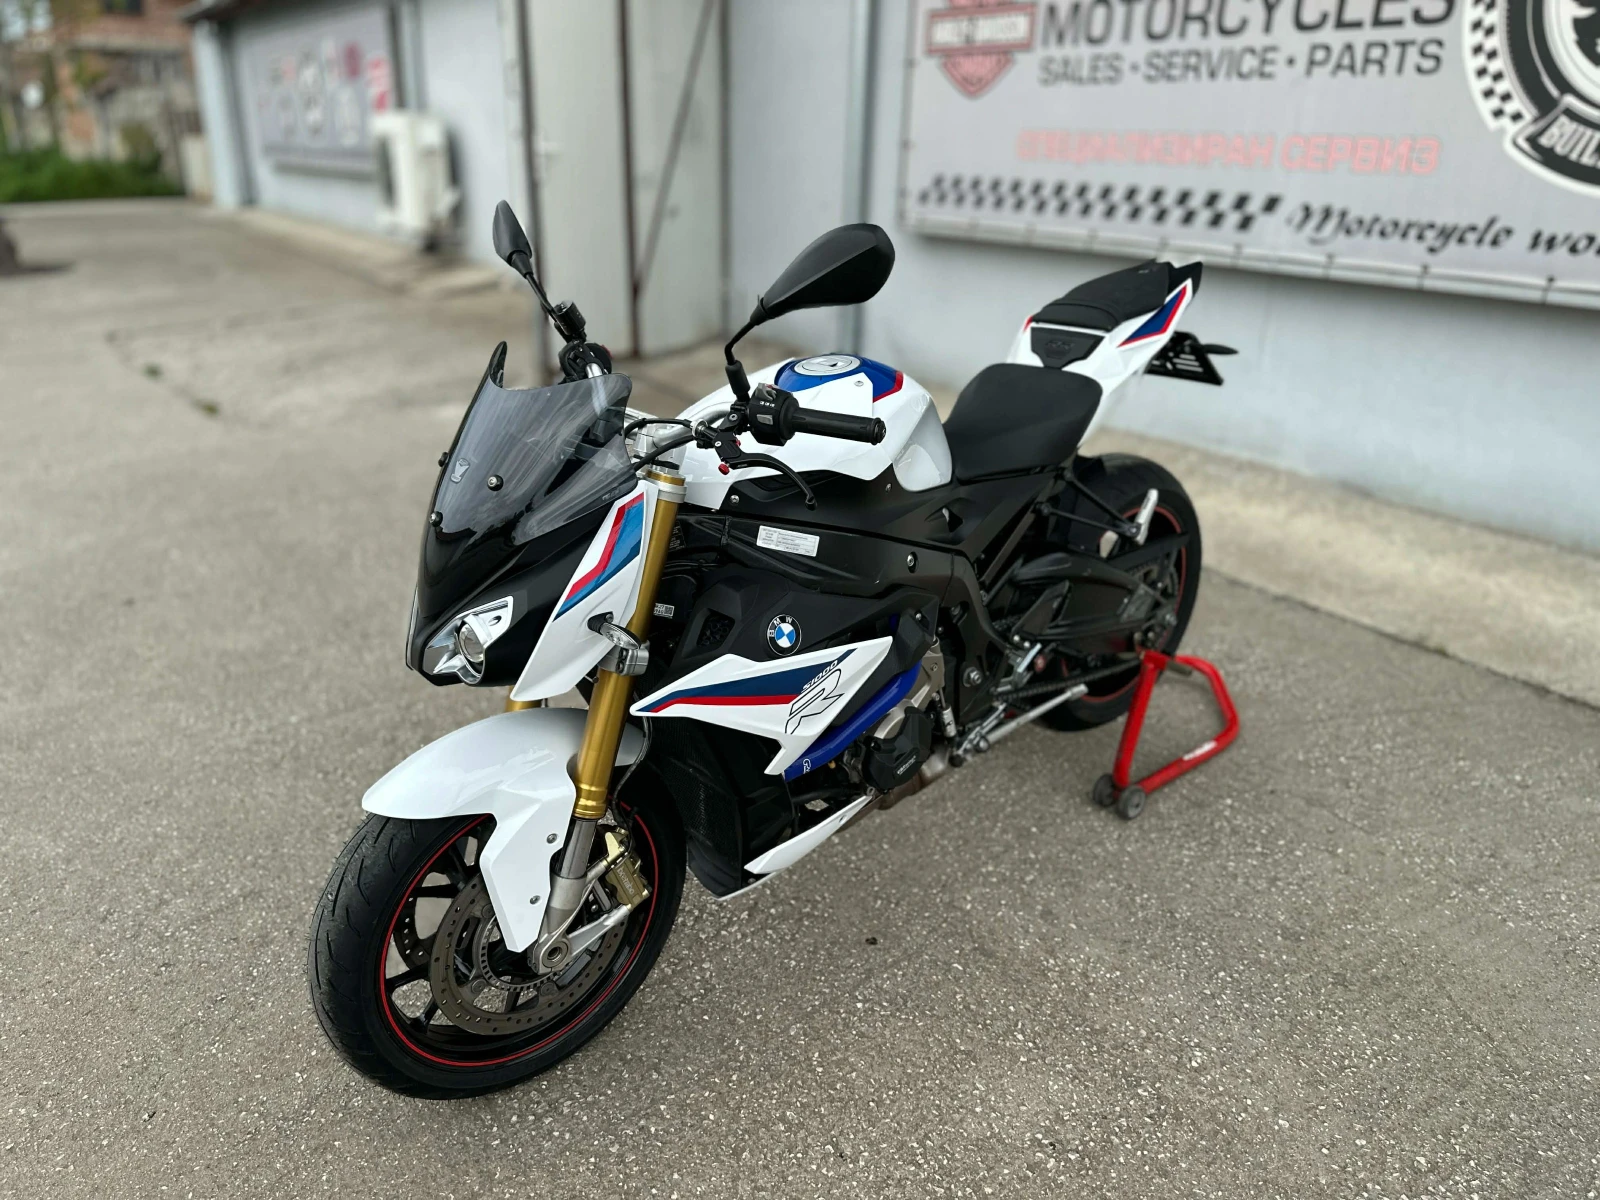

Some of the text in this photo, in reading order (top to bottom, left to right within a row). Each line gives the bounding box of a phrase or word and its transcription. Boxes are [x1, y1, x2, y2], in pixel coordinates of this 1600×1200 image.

[1039, 38, 1445, 86] SALES SERVICE PARTS
[1281, 135, 1440, 174] СЕРВИЗ
[1537, 113, 1600, 170] BUIL
[1286, 202, 1512, 254] Motorcycle
[769, 616, 793, 638] BMW
[801, 660, 838, 693] S1000
